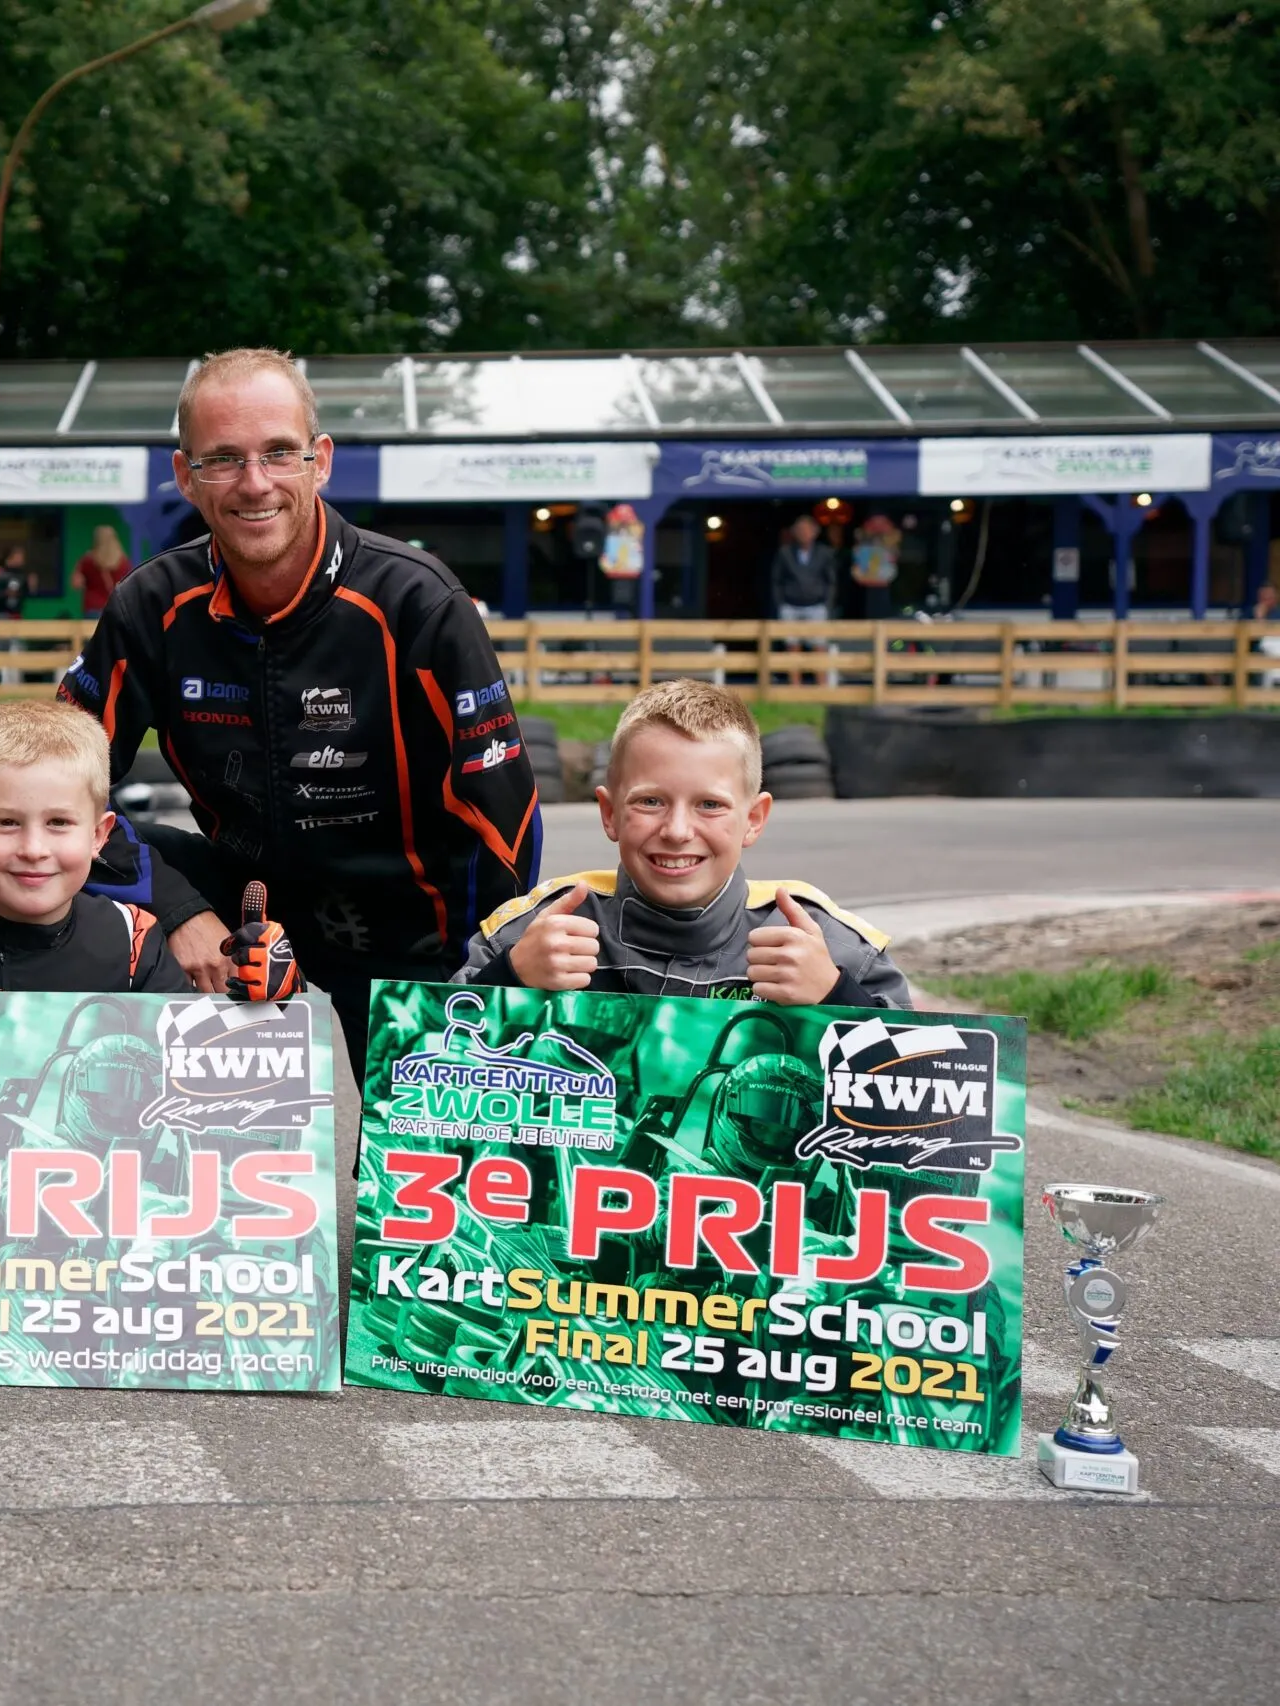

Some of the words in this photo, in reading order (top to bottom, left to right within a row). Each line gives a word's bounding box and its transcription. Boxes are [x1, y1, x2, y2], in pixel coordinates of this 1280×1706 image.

[183, 710, 253, 727] HONDA
[458, 712, 515, 740] HONDA
[708, 985, 753, 1001] KAR
[256, 1031, 273, 1039] THE
[274, 1031, 304, 1039] HAGUE
[169, 1047, 305, 1079] KWM
[932, 1060, 952, 1070] THE
[953, 1062, 988, 1072] HAGUE
[393, 1062, 616, 1097] KARTCENTRUM
[830, 1071, 988, 1117] KWM
[147, 1095, 331, 1127] Racing
[291, 1114, 306, 1123] NL
[389, 1085, 616, 1131] ZWOLLE
[388, 1118, 468, 1139] KARTEN
[470, 1124, 510, 1142] DOE
[513, 1127, 540, 1145] JE
[540, 1130, 614, 1150] BUITEN
[803, 1126, 1015, 1166] Racing
[968, 1156, 985, 1166] NL
[380, 1150, 529, 1245] 3e
[568, 1165, 993, 1295] PRIJS
[22, 1299, 82, 1335] 25
[93, 1304, 183, 1342] aug
[194, 1301, 315, 1338] 2021
[375, 1255, 987, 1357] KartSummerSchool
[28, 1346, 222, 1375] wedstrijddag
[230, 1353, 314, 1373] racen
[525, 1317, 649, 1367] Final
[659, 1331, 725, 1374] 25
[736, 1344, 838, 1392] aug
[849, 1350, 986, 1402] 2021
[371, 1355, 412, 1373] Prijs:
[414, 1361, 518, 1385] uitgenodigd
[521, 1374, 561, 1388] voor
[565, 1379, 599, 1393] een
[603, 1381, 672, 1402] testdag
[675, 1390, 712, 1405] met
[715, 1394, 750, 1410] een
[754, 1397, 882, 1424] professioneel
[886, 1413, 928, 1430] race
[932, 1416, 983, 1435] team
